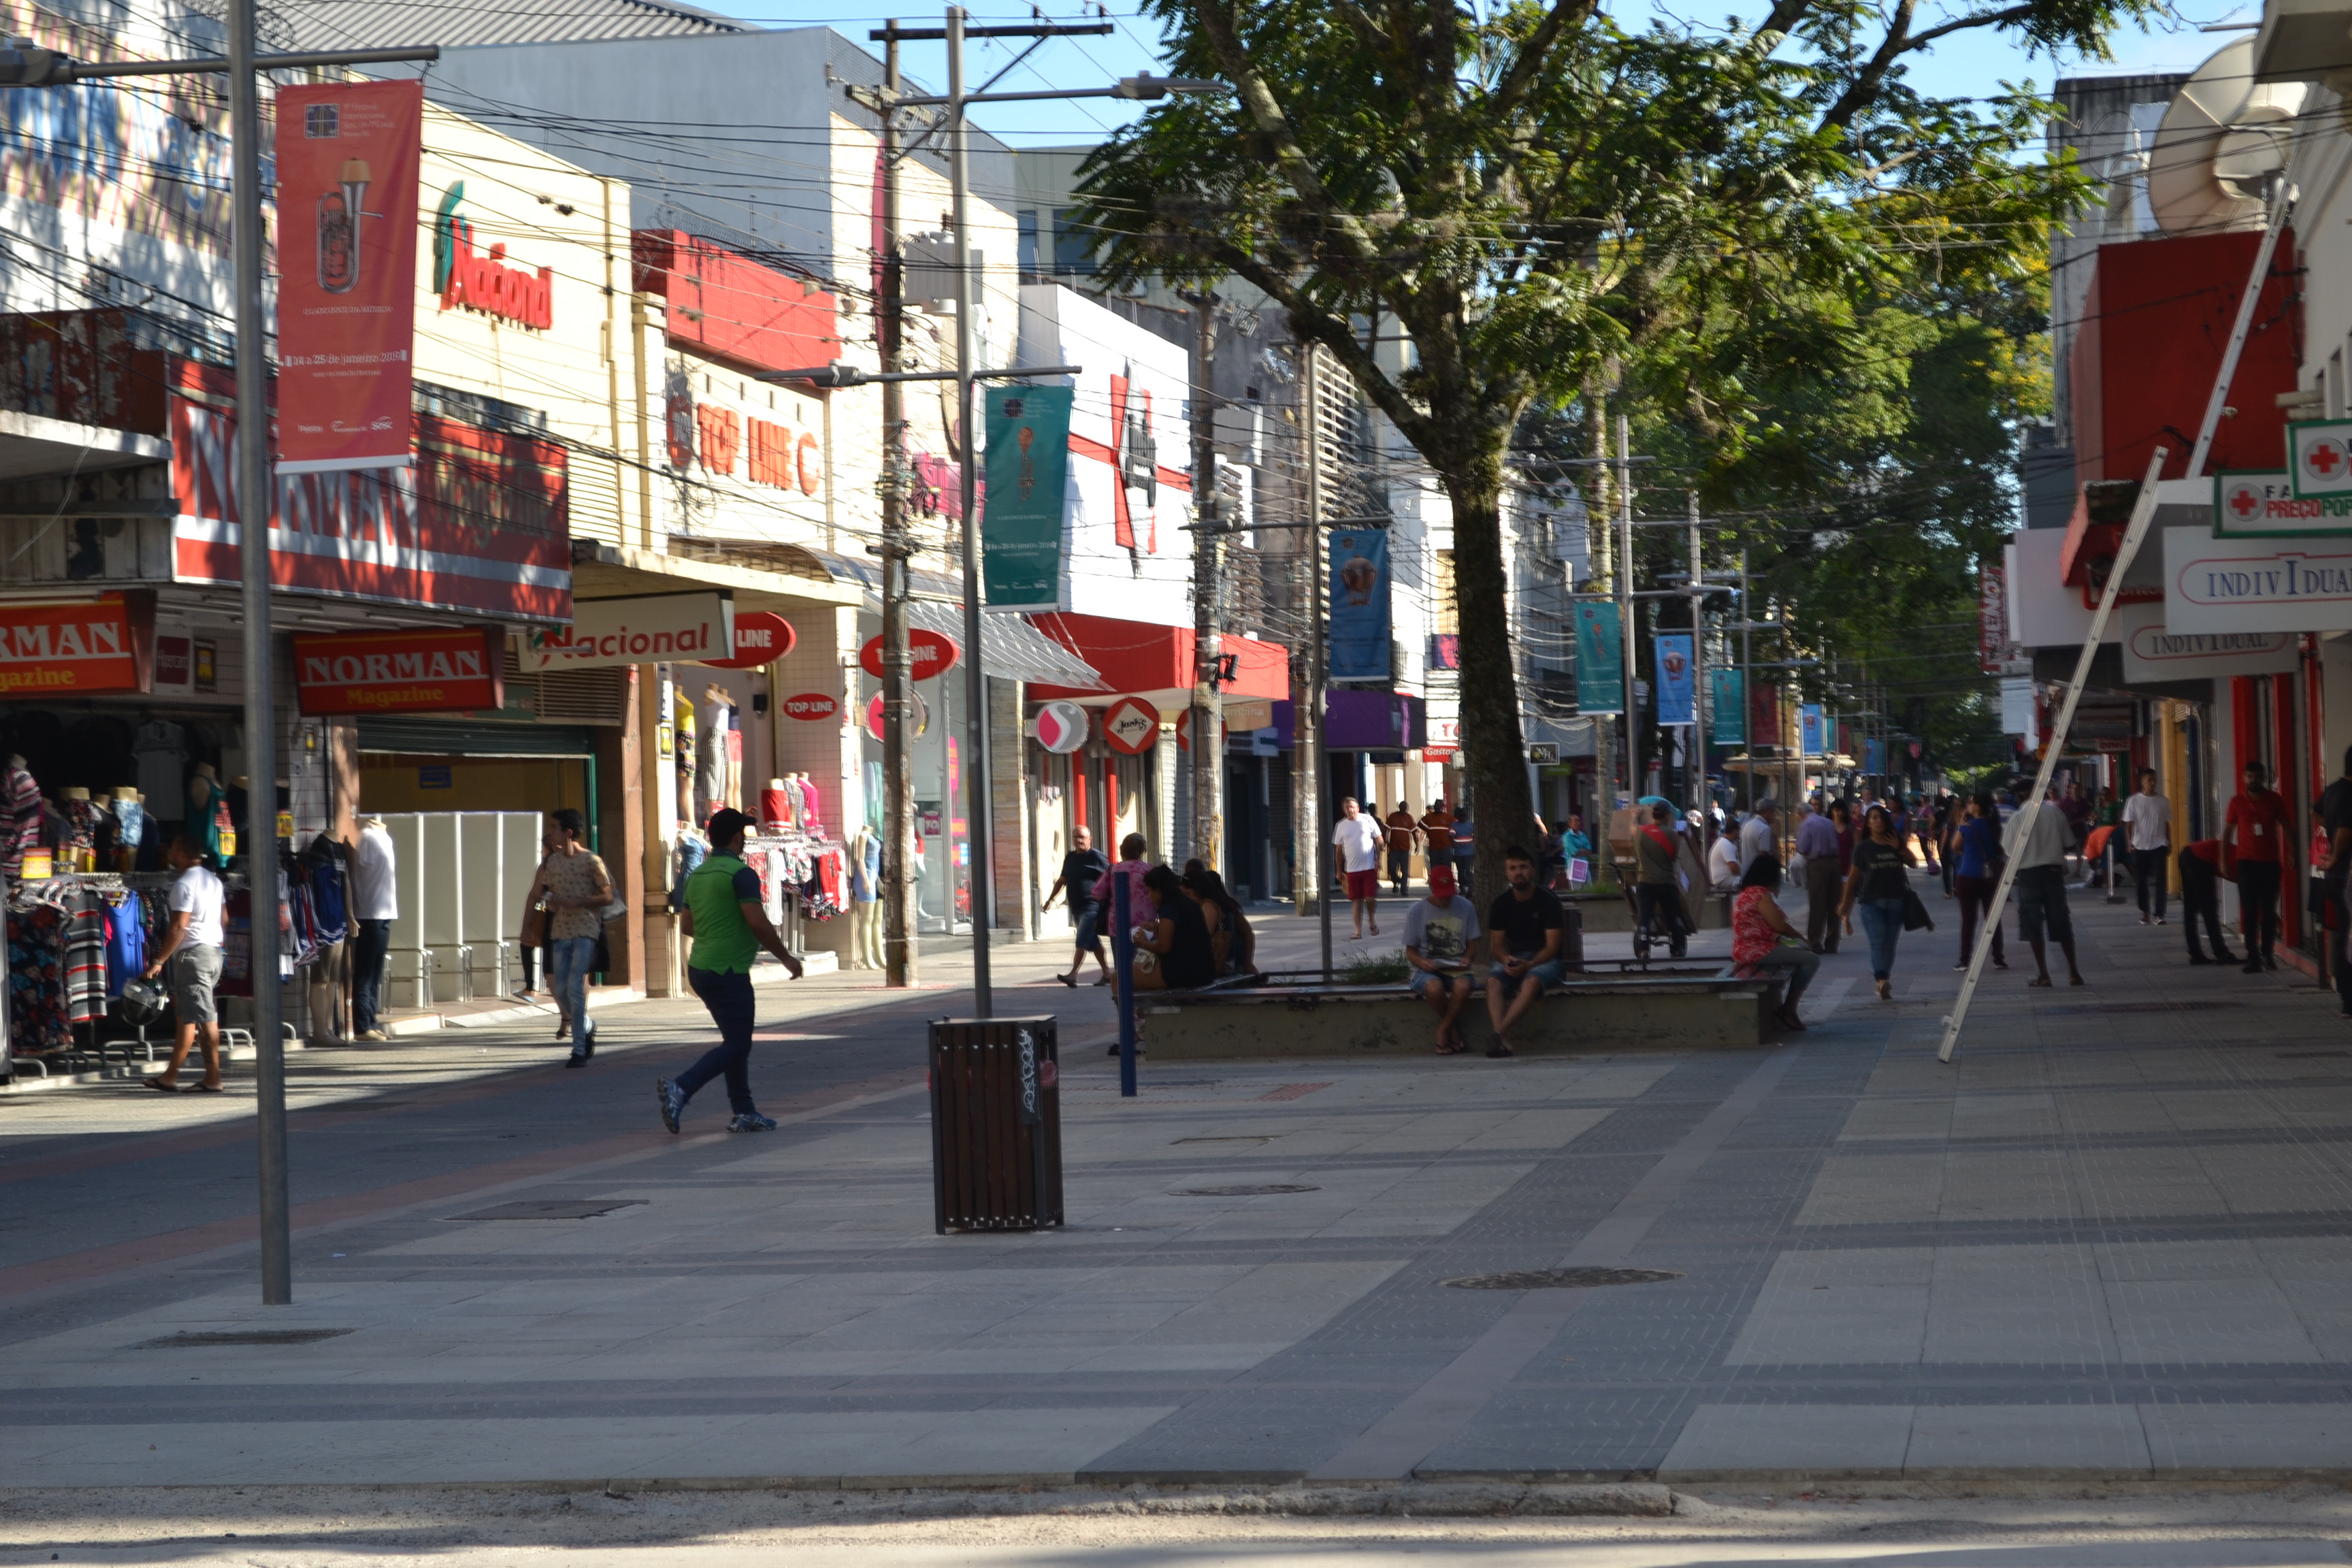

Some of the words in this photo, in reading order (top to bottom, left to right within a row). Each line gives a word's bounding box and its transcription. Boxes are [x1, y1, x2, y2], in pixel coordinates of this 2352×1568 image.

[440, 219, 552, 330] Nacional
[697, 402, 740, 474] TOP
[748, 416, 793, 491] LINE
[537, 622, 709, 668] Nacional
[735, 627, 772, 649] LINE
[303, 650, 483, 685] NORMAN
[346, 687, 445, 706] Magazine
[787, 702, 808, 713] TOP
[809, 701, 834, 713] LINE
